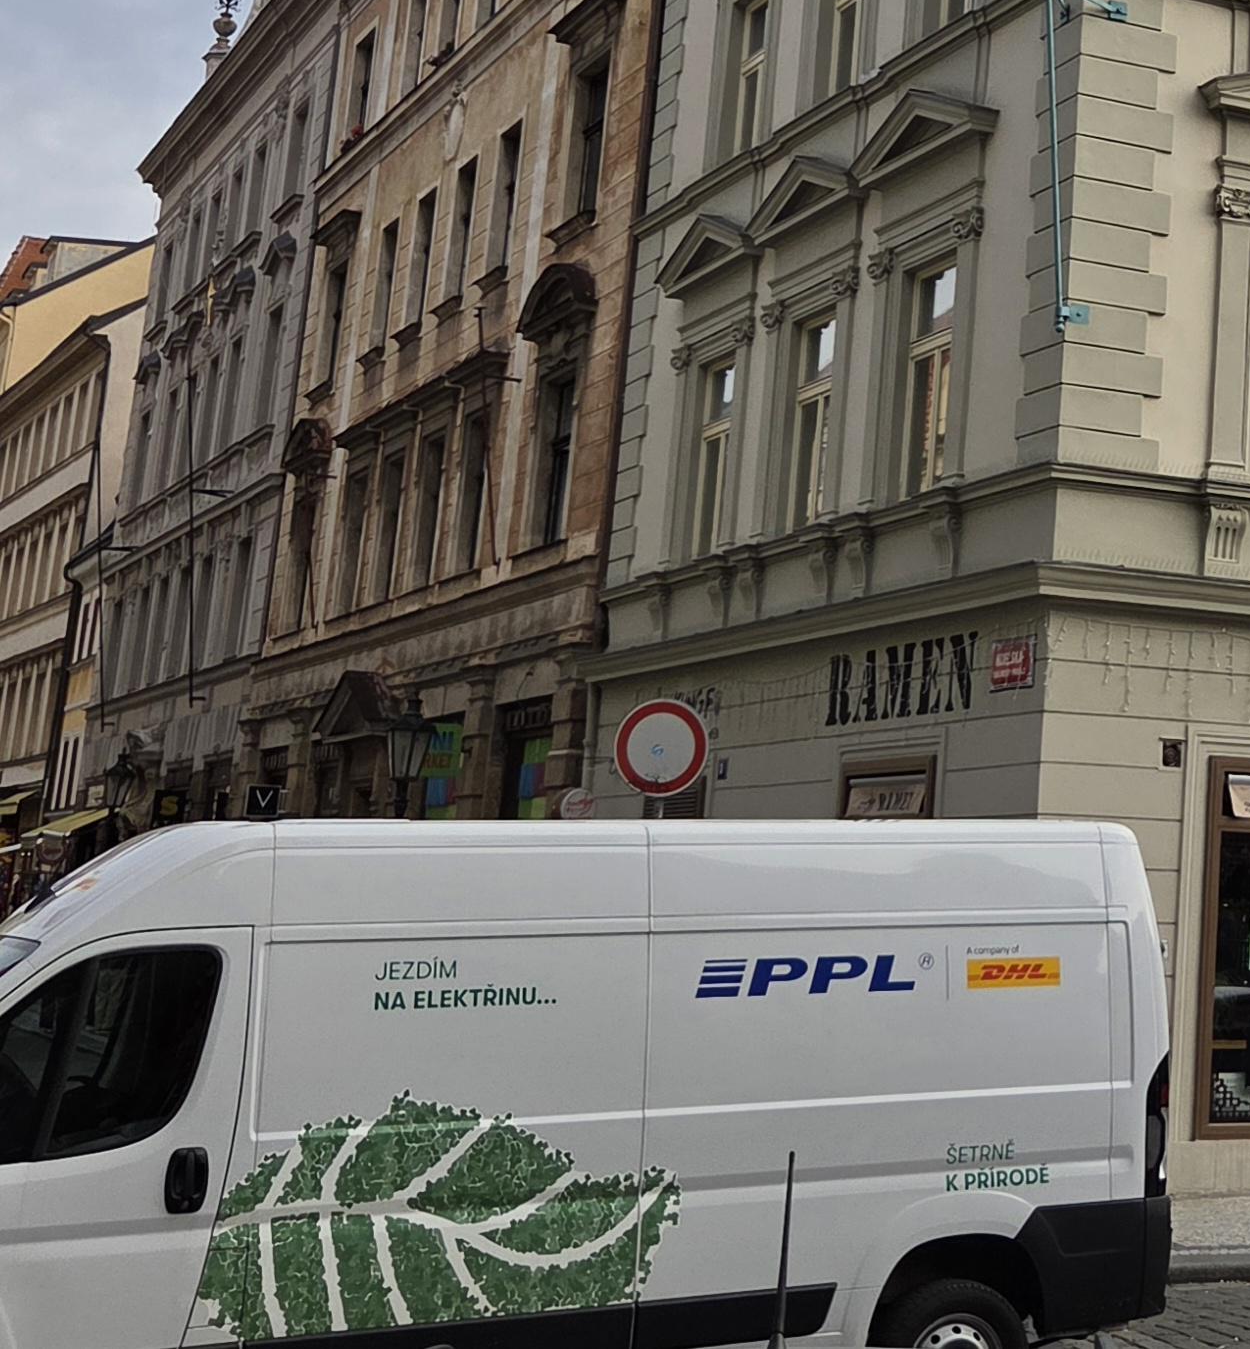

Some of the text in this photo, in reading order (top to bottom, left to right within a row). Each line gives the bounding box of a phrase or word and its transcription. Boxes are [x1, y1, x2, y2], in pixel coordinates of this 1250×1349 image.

[825, 631, 978, 726] RAMEN
[966, 944, 1020, 956] A company of
[375, 956, 458, 981] JEZDÍM
[748, 955, 915, 996] PPL
[980, 963, 1048, 980] DHL
[374, 983, 557, 1011] NA ELEKTŘINU...
[946, 1138, 1015, 1165] ŠETRNĚ
[946, 1162, 1050, 1191] K PŘÍRODĚ
